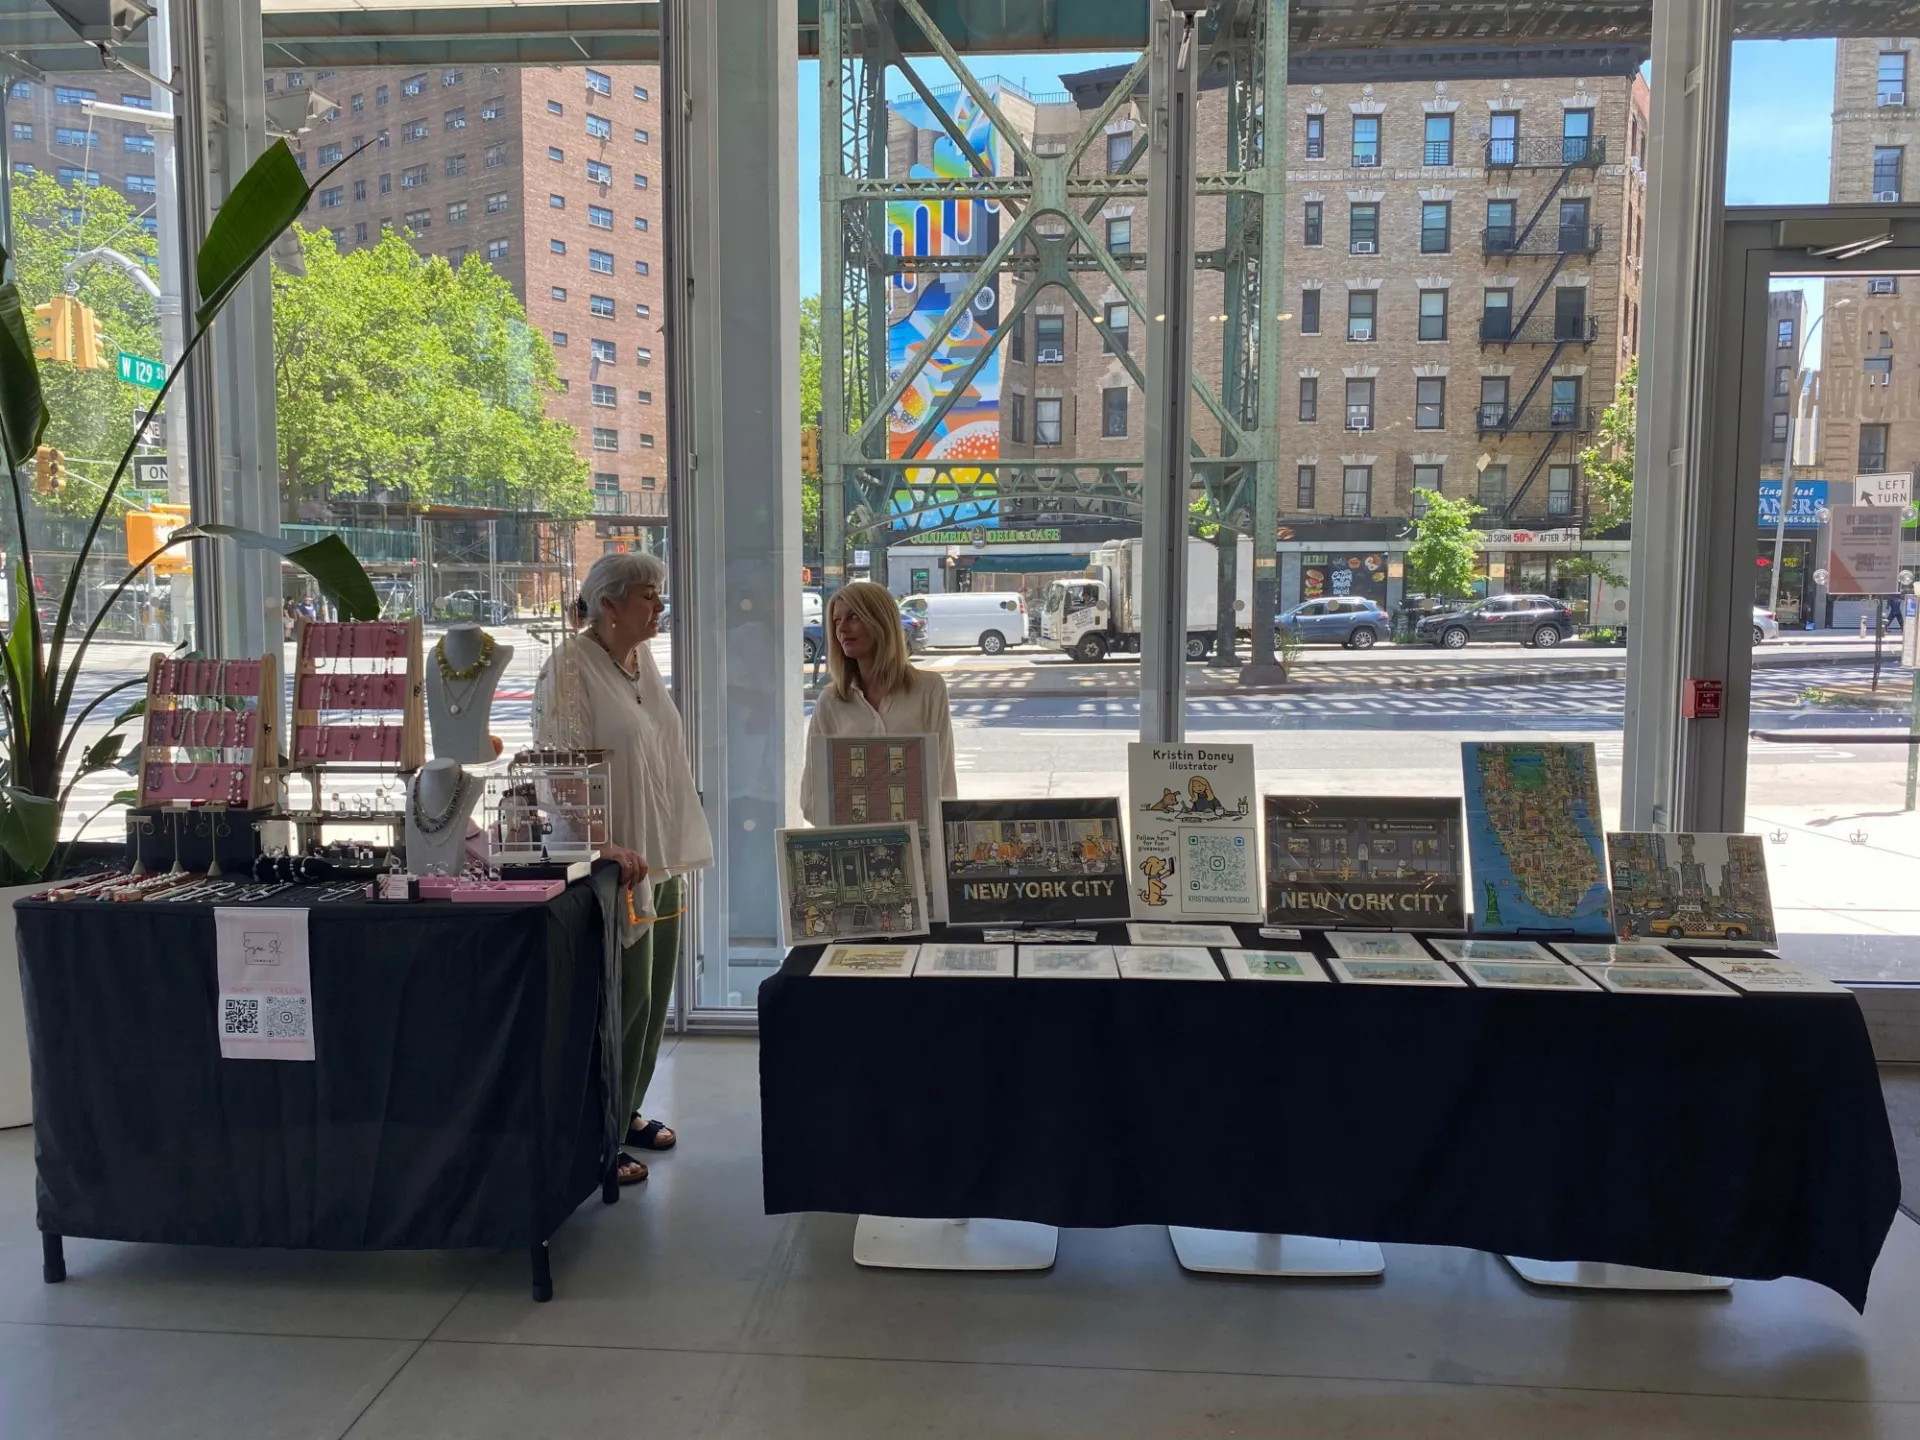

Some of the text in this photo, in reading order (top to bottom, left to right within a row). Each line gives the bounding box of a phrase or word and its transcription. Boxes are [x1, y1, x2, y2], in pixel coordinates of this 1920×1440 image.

[122, 356, 131, 378] W
[135, 360, 153, 383] 129
[1878, 479, 1906, 490] LEFT
[1793, 486, 1815, 496] est
[1877, 493, 1908, 504] TURN
[910, 531, 970, 544] COLUMBIA
[1029, 528, 1061, 542] CAFE
[1494, 534, 1512, 542] SUSHI
[1514, 532, 1532, 542] 50%
[1540, 534, 1560, 542] AFTER
[1152, 750, 1234, 764] Kristin Doney
[1169, 762, 1218, 770] illustrator
[964, 880, 1114, 900] NEW YORK CITY
[1281, 892, 1448, 912] NEW YORK CITY
